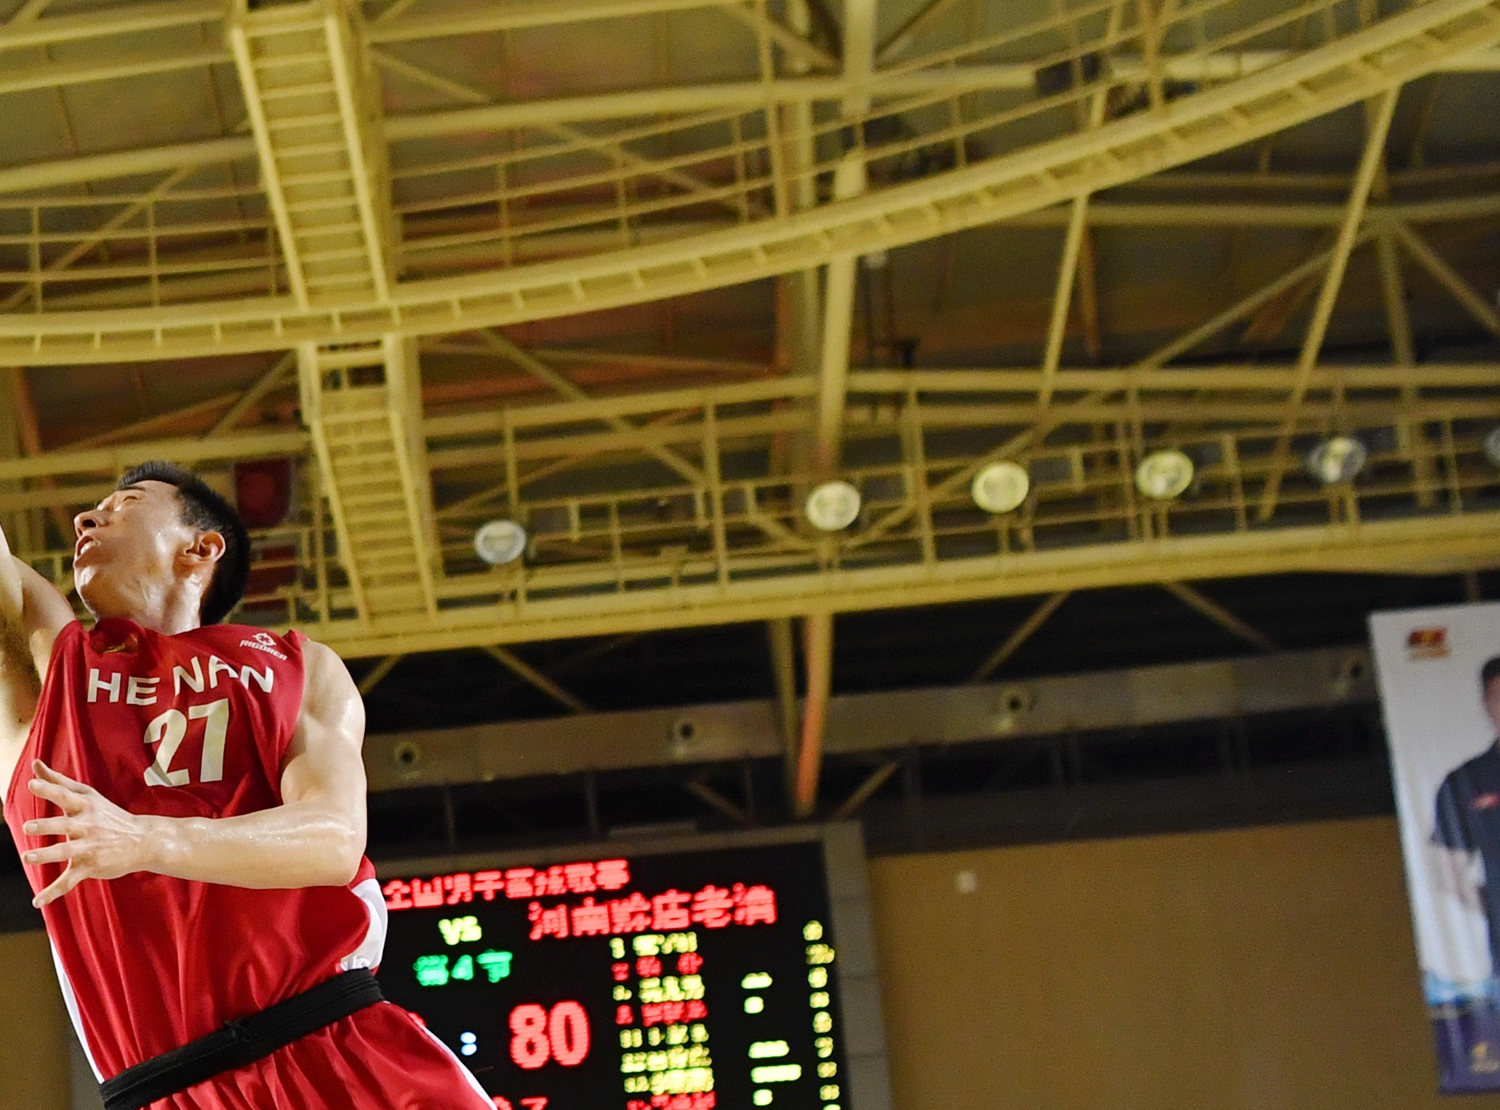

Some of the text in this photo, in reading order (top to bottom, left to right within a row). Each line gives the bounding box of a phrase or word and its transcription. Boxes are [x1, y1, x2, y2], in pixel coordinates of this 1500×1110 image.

[86, 654, 275, 706] HE NAN
[142, 698, 230, 788] 27
[508, 1000, 591, 1070] 80
